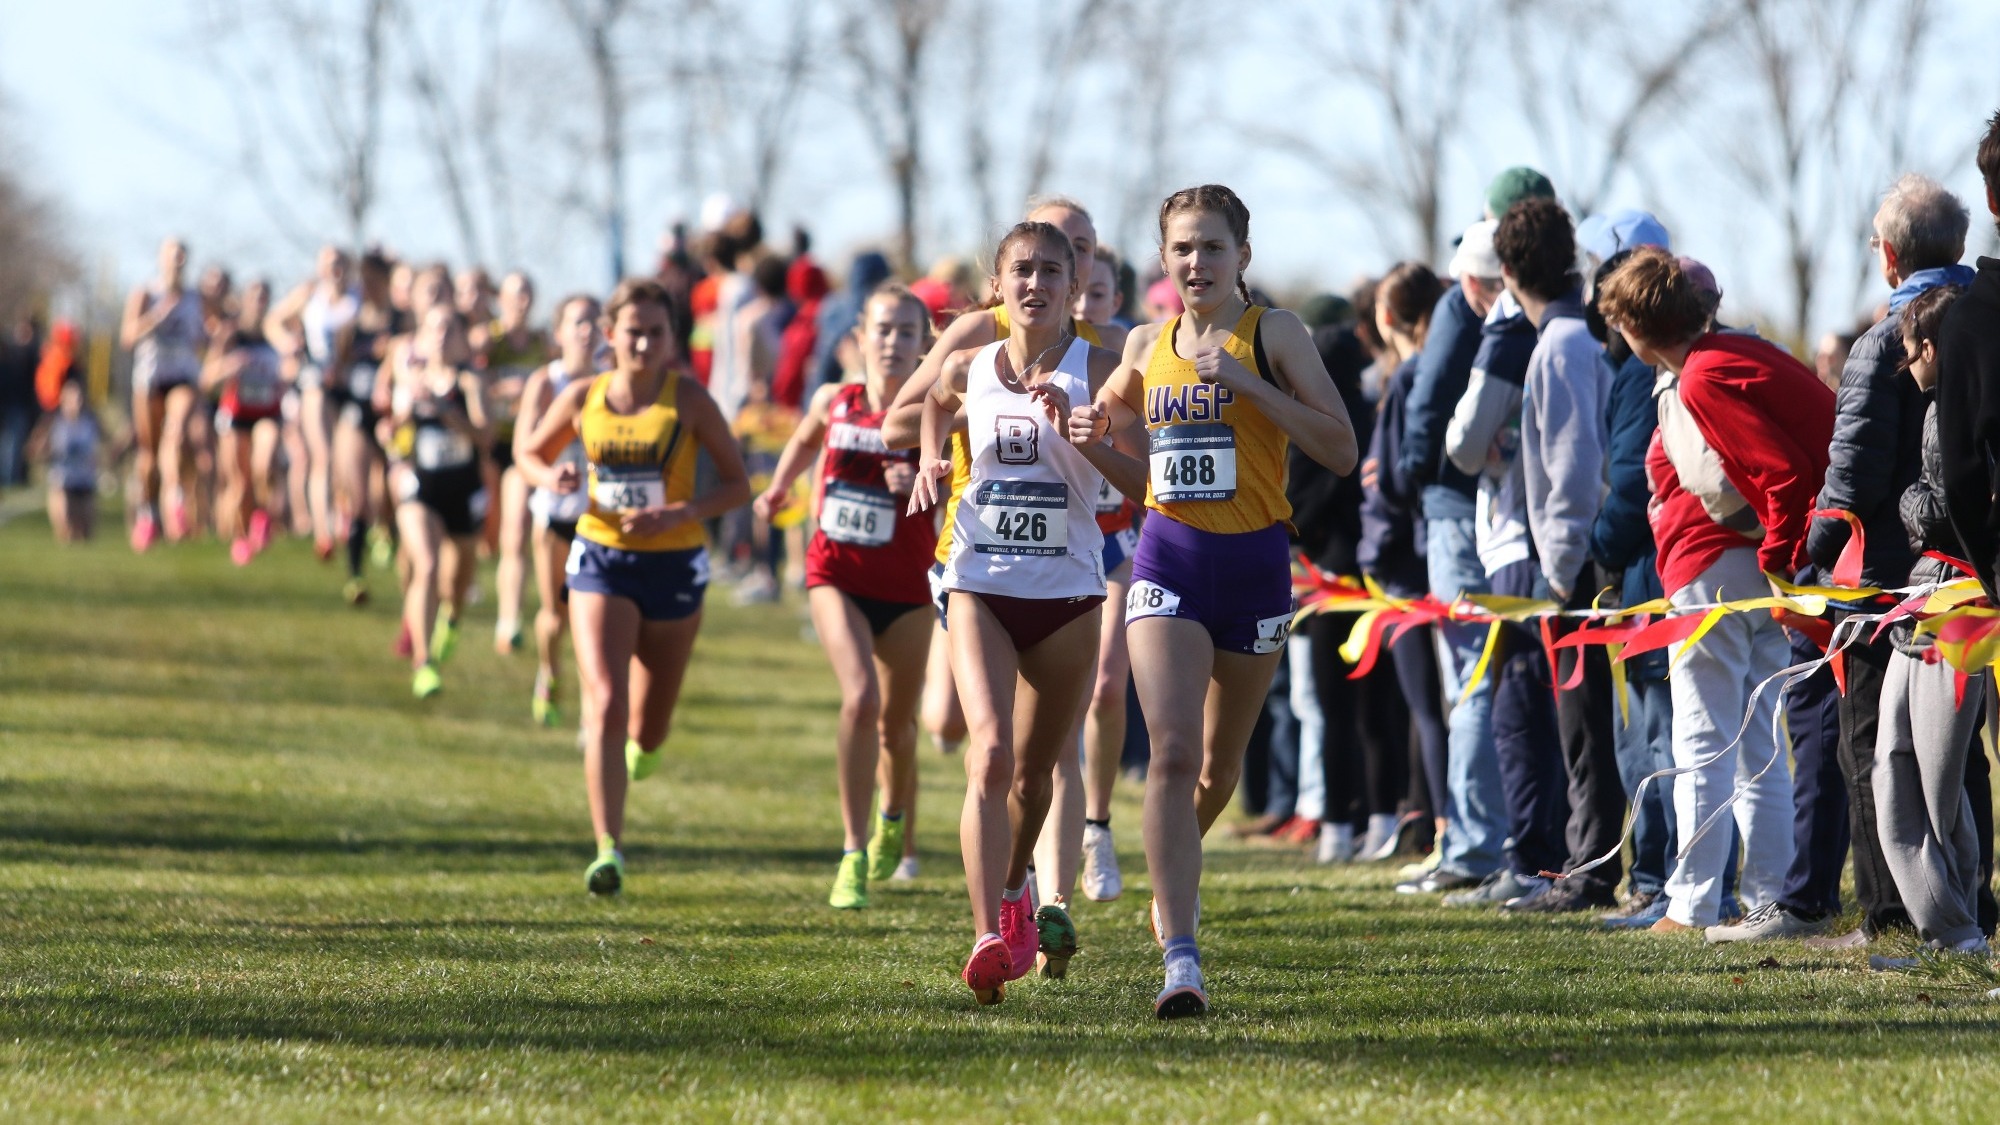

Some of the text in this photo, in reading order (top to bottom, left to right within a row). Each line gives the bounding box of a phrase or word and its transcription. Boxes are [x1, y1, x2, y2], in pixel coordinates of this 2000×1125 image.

[1147, 382, 1234, 424] UWSP
[828, 422, 911, 457] LYNCHB
[994, 415, 1039, 465] B
[1164, 454, 1216, 486] 488
[837, 507, 877, 534] 646
[995, 511, 1047, 542] 426
[1128, 587, 1165, 611] 488
